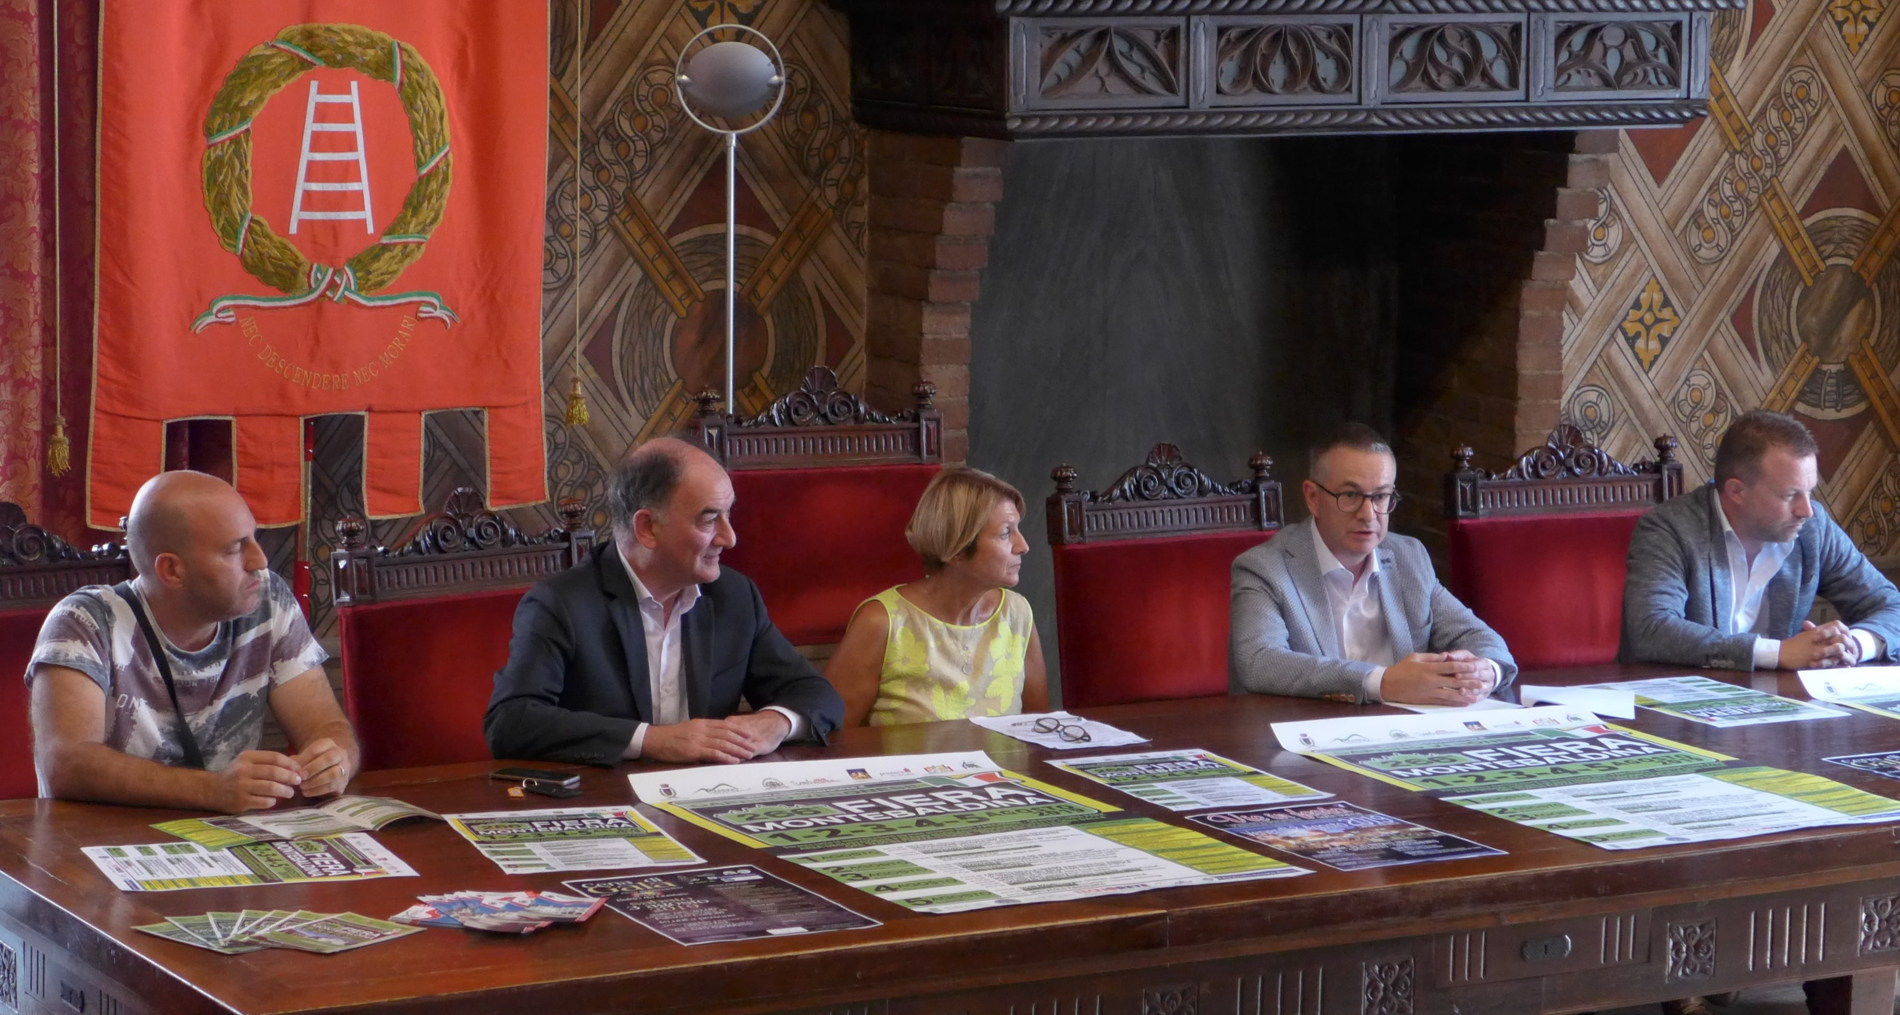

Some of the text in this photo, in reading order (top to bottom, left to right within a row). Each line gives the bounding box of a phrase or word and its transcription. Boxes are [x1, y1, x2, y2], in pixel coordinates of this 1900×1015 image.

[239, 314, 418, 391] NEC DESCENDERE NEC MORARI
[1390, 746, 1673, 778] MONTEBALDINA
[1462, 737, 1649, 763] FIERA
[742, 796, 1056, 832] MONTEBALDINA
[833, 786, 1037, 814] FIERA
[531, 818, 627, 828] FIERA
